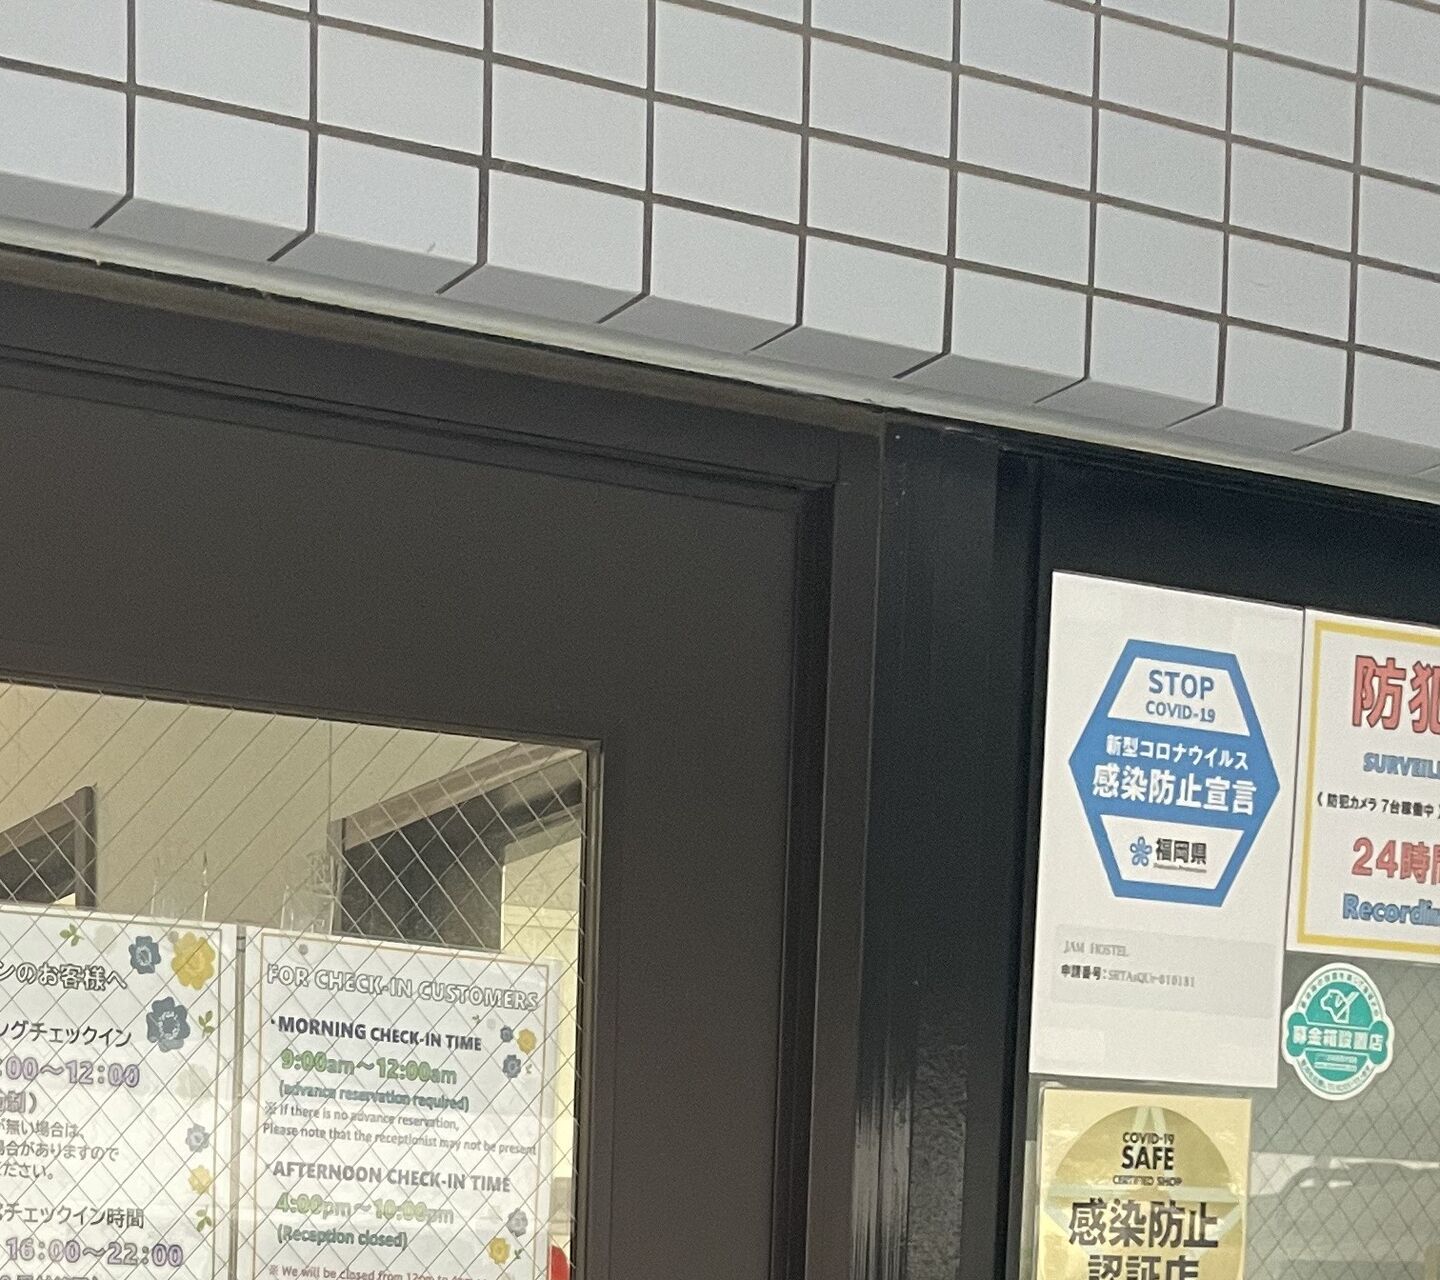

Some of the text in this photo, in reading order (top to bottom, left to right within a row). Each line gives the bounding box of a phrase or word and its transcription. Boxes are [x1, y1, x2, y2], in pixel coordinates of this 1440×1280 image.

[1148, 669, 1216, 700] STOP
[1145, 701, 1217, 724] COVID-19
[1105, 734, 1250, 772] 新型コロナウイルス
[1092, 763, 1258, 816] 感染防止宣言
[1155, 837, 1207, 865] 福岡県
[1090, 942, 1129, 957] HOSTEL
[267, 963, 539, 1011] FOR CHECK-IN CUSTOMERS
[370, 1027, 442, 1048] CHECK-IN
[446, 1034, 482, 1051] TIME
[339, 1088, 410, 1106] reservation
[291, 1105, 320, 1119] there
[350, 1110, 394, 1126] advance
[263, 1123, 299, 1137] Please
[301, 1126, 326, 1139] note
[329, 1127, 351, 1141] that
[354, 1130, 372, 1142] the
[375, 1133, 437, 1149] receptionist
[440, 1138, 460, 1151] may
[464, 1140, 482, 1152] not
[1122, 1131, 1176, 1145] COVID-19
[1121, 1145, 1176, 1171] SAFE
[387, 1168, 465, 1190] CHECK-IN
[471, 1175, 511, 1193] TIME
[1156, 1176, 1183, 1187] SHOP
[1068, 1196, 1220, 1250] 感染防止
[282, 1266, 299, 1278] We
[302, 1267, 320, 1279] will
